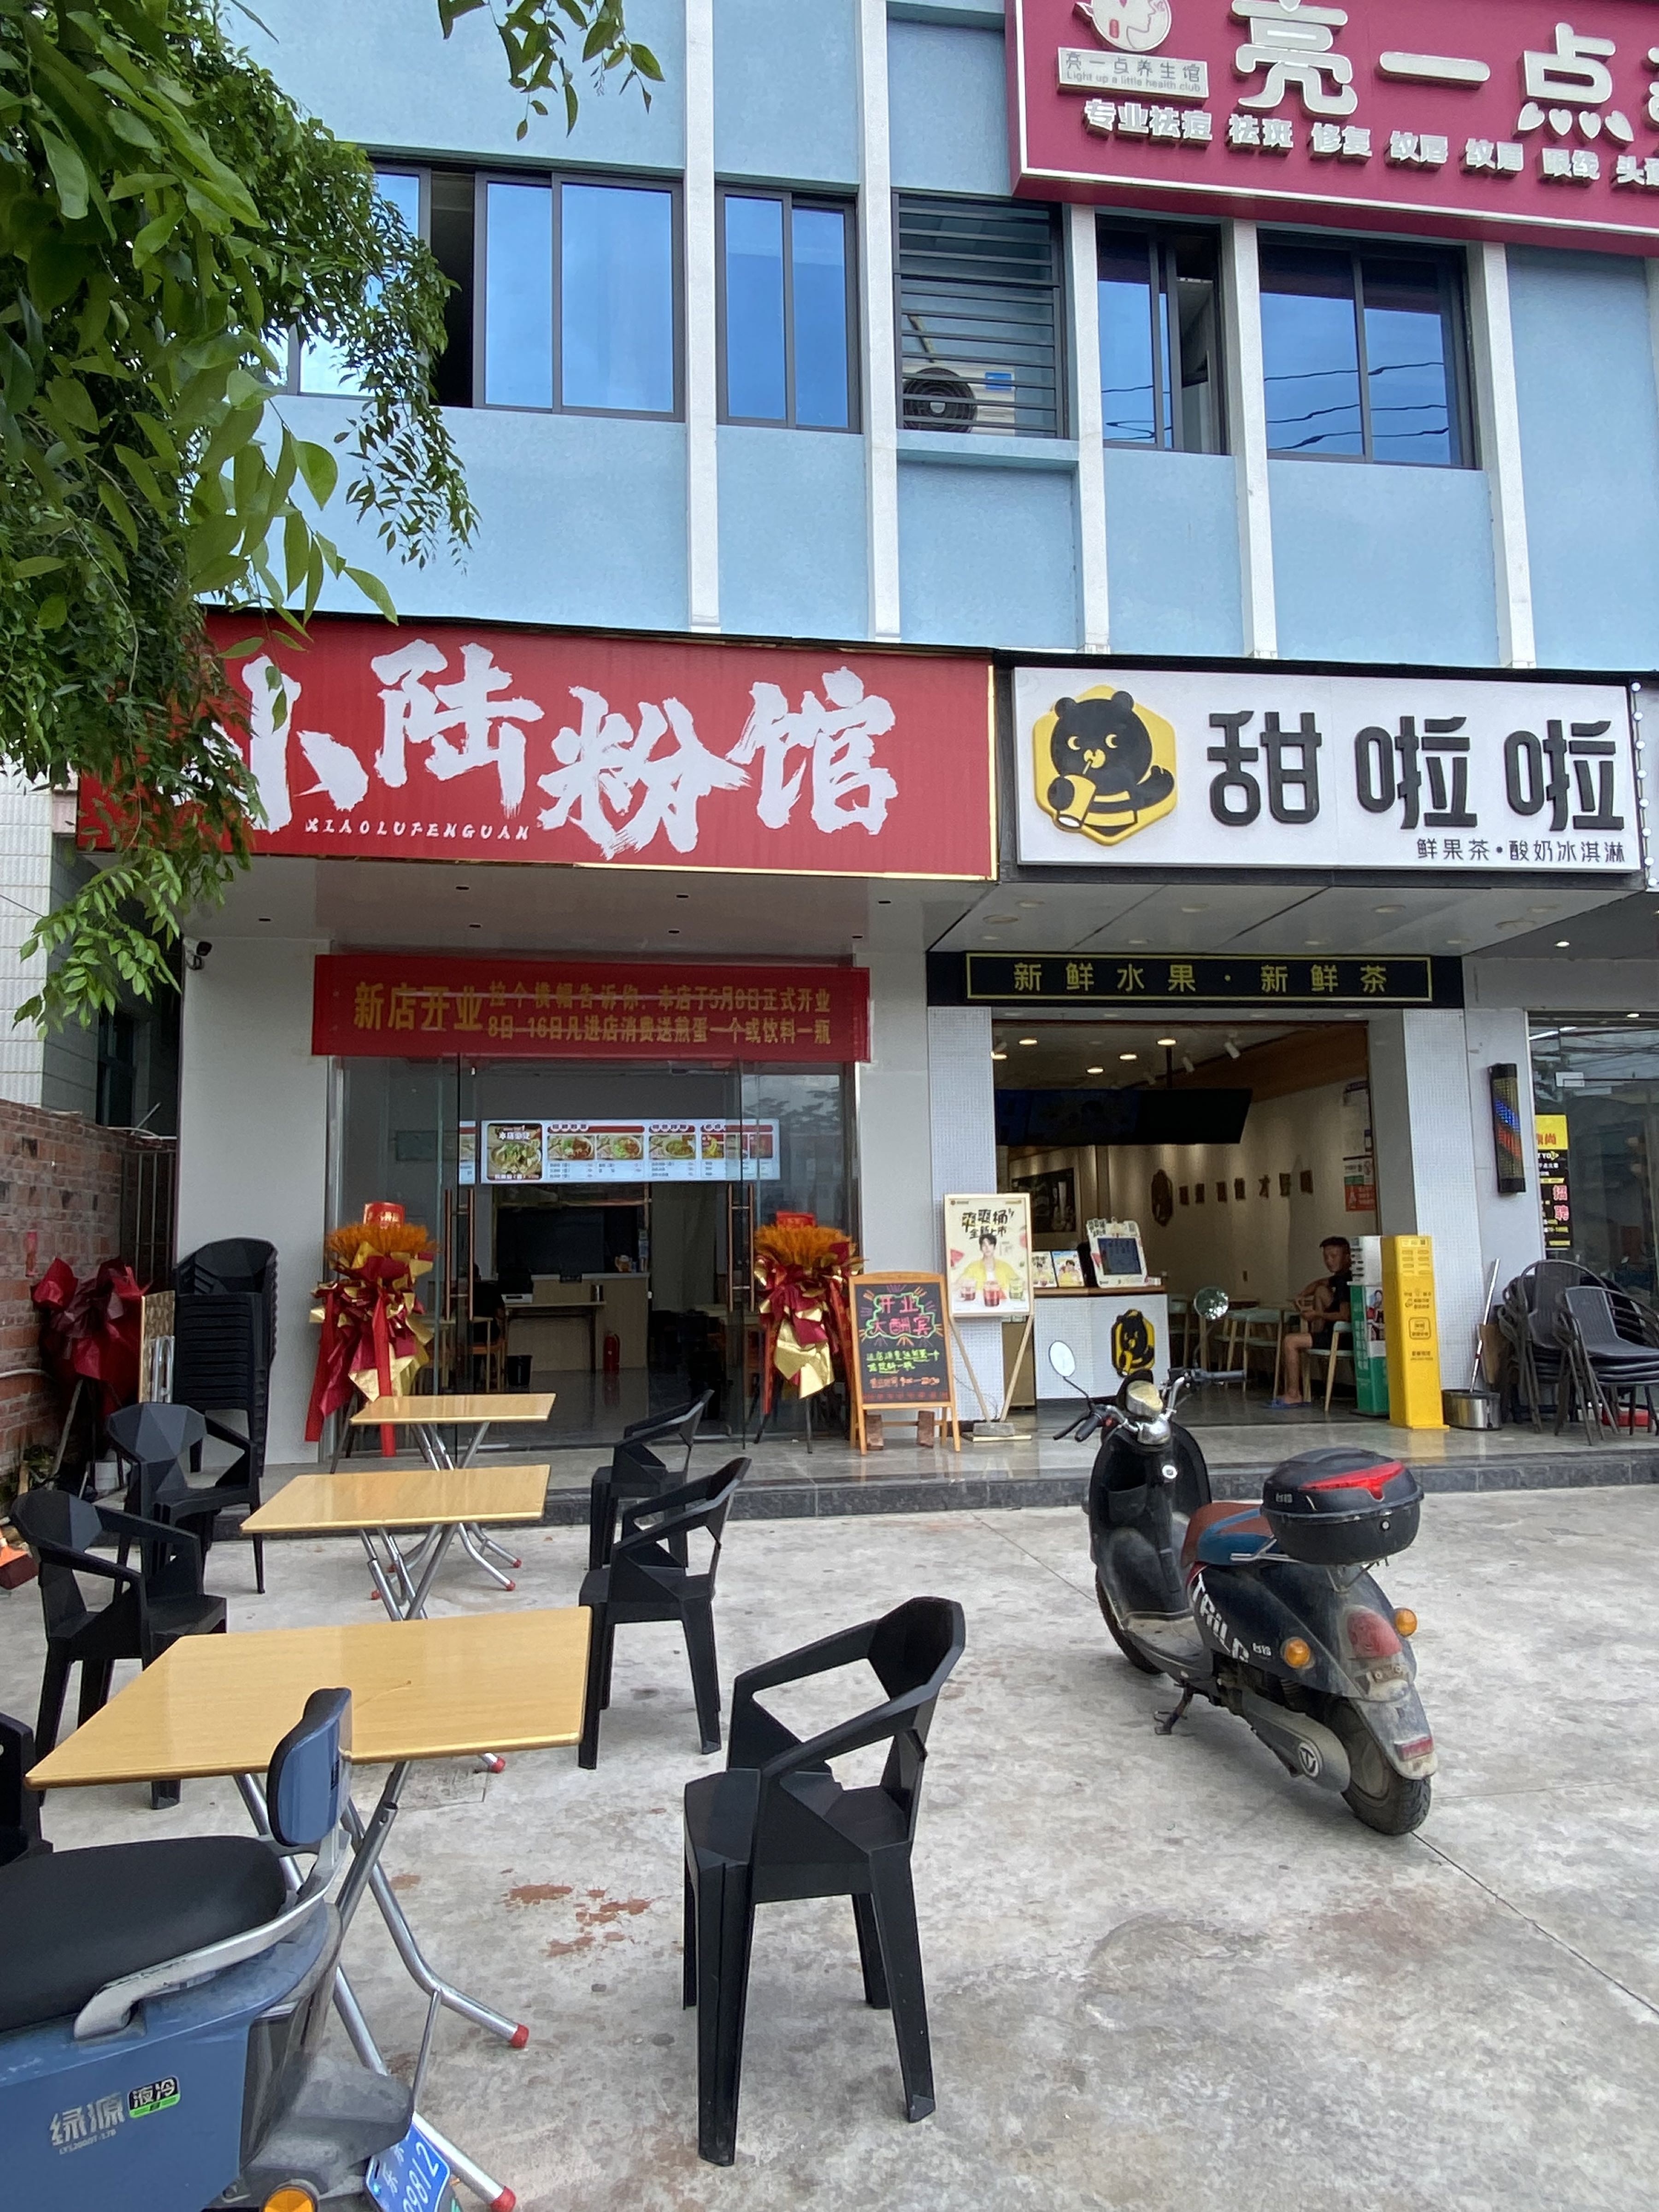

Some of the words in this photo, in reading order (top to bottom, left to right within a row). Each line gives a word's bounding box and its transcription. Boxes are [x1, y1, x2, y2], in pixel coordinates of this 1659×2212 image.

[1065, 51, 1200, 82] 亮一点养生馆
[1066, 71, 1092, 82] Light
[1095, 75, 1108, 84] up
[1120, 75, 1142, 86] little
[1145, 79, 1177, 89] health
[1179, 82, 1200, 92] club
[1231, 0, 1659, 143] 亮一点
[1084, 98, 1213, 141] 专业祛痘
[1229, 114, 1294, 148] 祛斑
[1311, 122, 1373, 158] 修复
[1465, 138, 1524, 171] 纹眉
[1541, 147, 1600, 180] 眼线
[184, 637, 901, 861] 小陆粉馆
[1206, 709, 1625, 831] 甜啦啦
[305, 817, 529, 841] XIAOLUFENGUAN
[353, 981, 483, 1031] 新店开业
[879, 1295, 918, 1314] 开业
[132, 2078, 176, 2108] 液冷
[49, 2092, 126, 2146] 绿源
